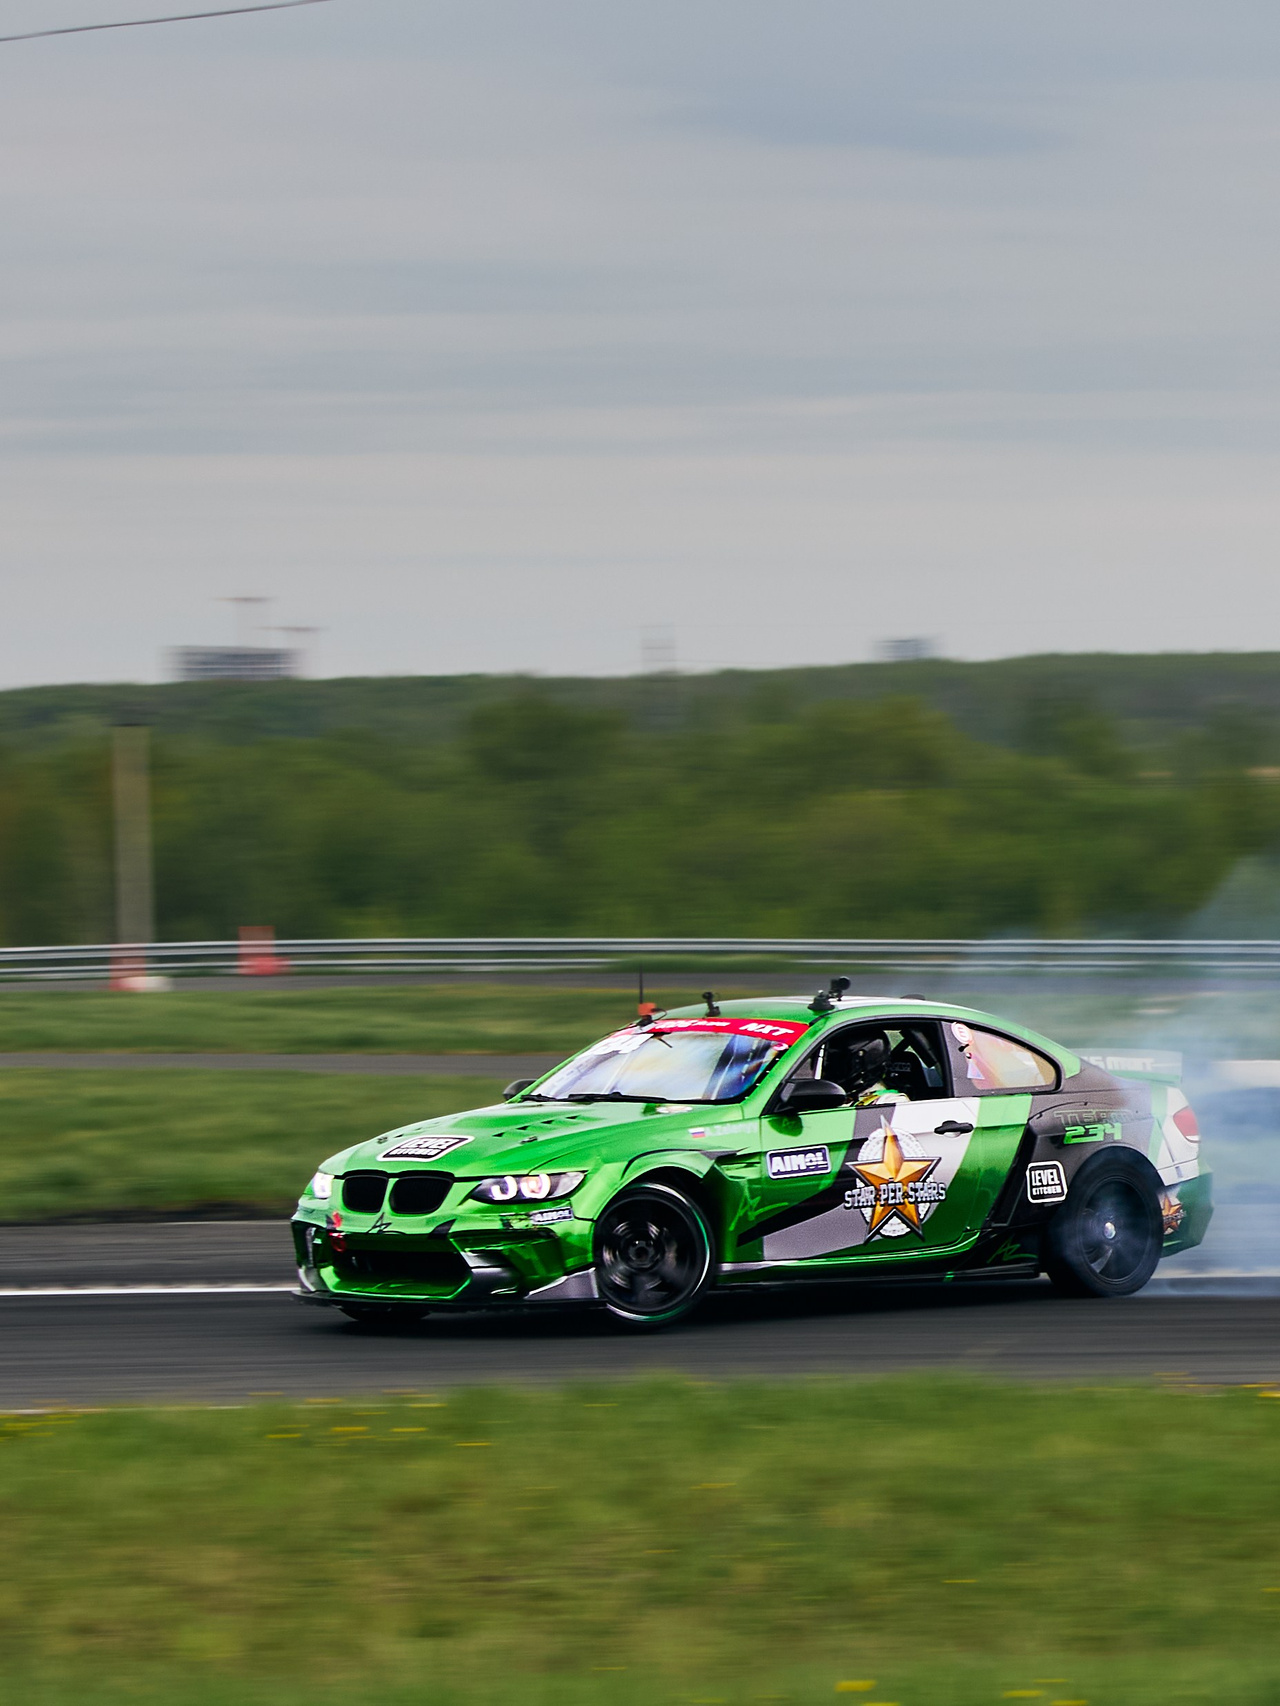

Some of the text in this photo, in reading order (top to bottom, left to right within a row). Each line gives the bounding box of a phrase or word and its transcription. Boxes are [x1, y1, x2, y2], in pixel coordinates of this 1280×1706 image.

[738, 1022, 795, 1037] NXT
[1063, 1123, 1122, 1144] 234
[771, 1151, 828, 1174] AIMOL
[1031, 1168, 1060, 1186] LEVEL
[844, 1181, 947, 1208] STAR PER STARS
